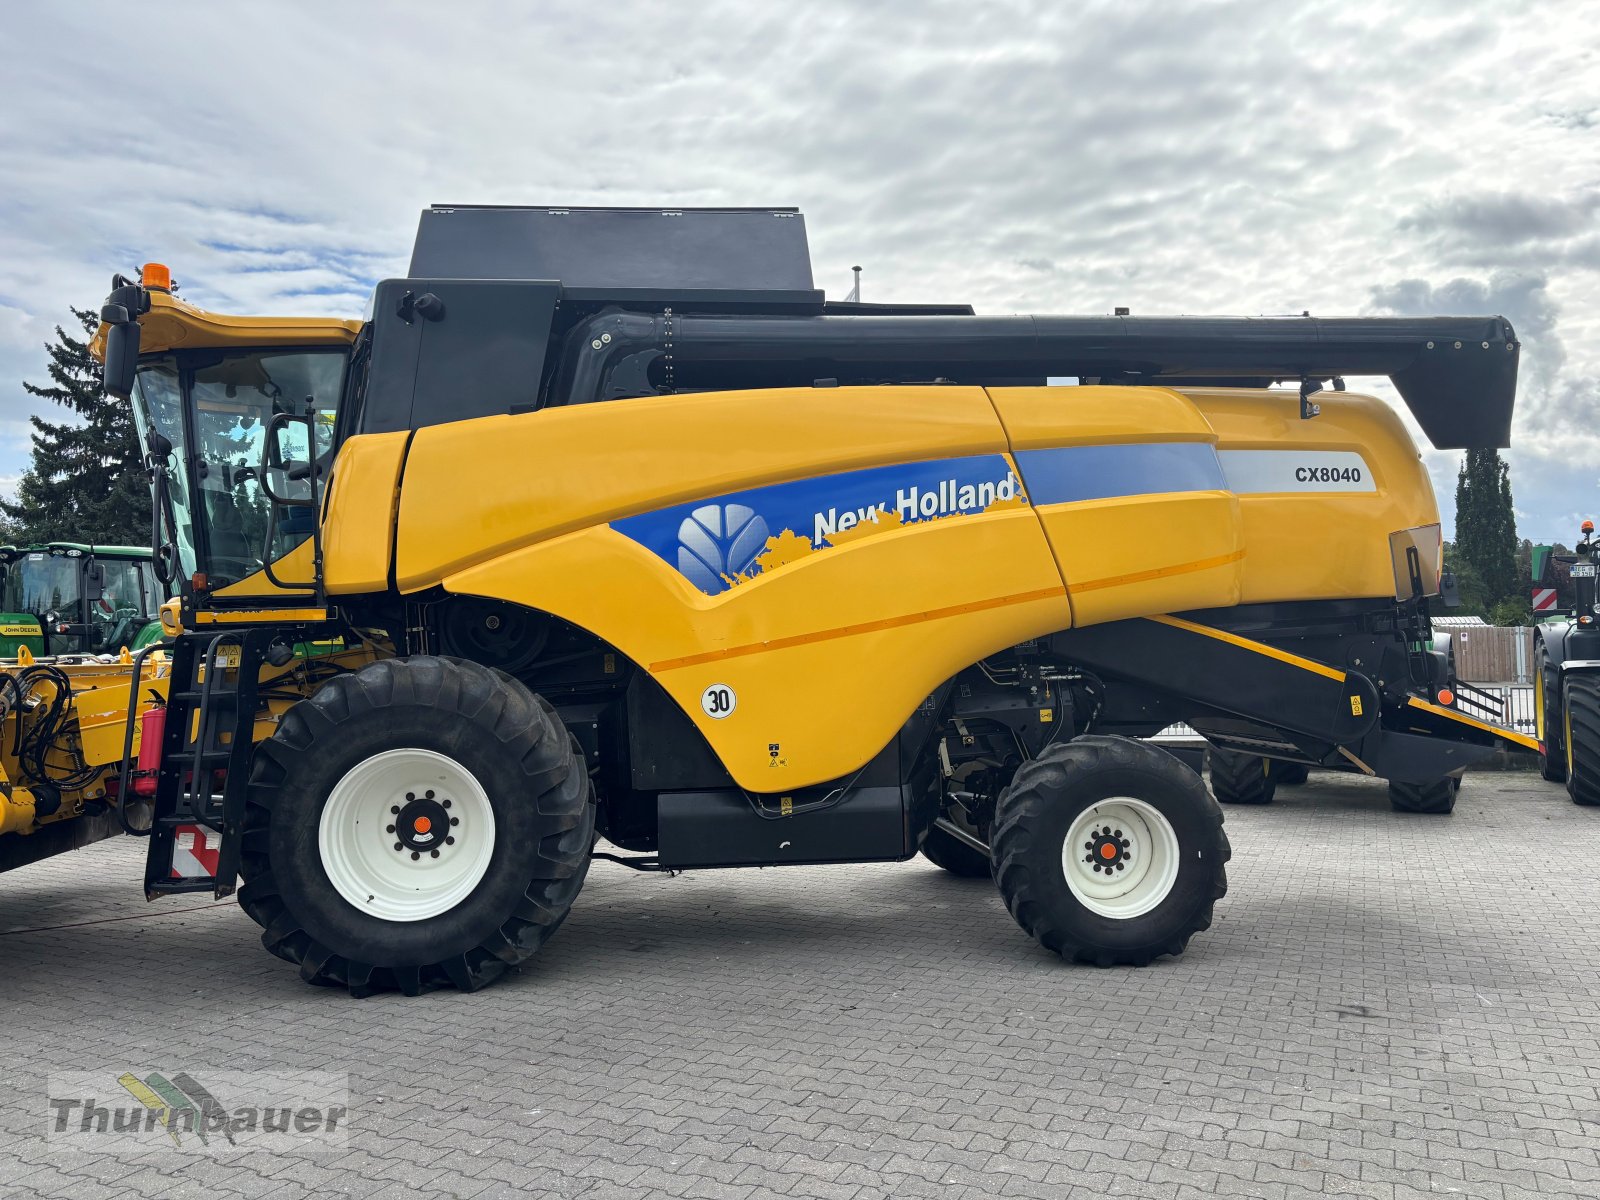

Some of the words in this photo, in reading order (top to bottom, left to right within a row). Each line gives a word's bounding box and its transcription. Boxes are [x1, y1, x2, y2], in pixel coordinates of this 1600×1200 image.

[1295, 467, 1361, 482] CX8040
[814, 502, 886, 546] New
[896, 471, 1015, 521] Holland
[708, 689, 730, 713] 30
